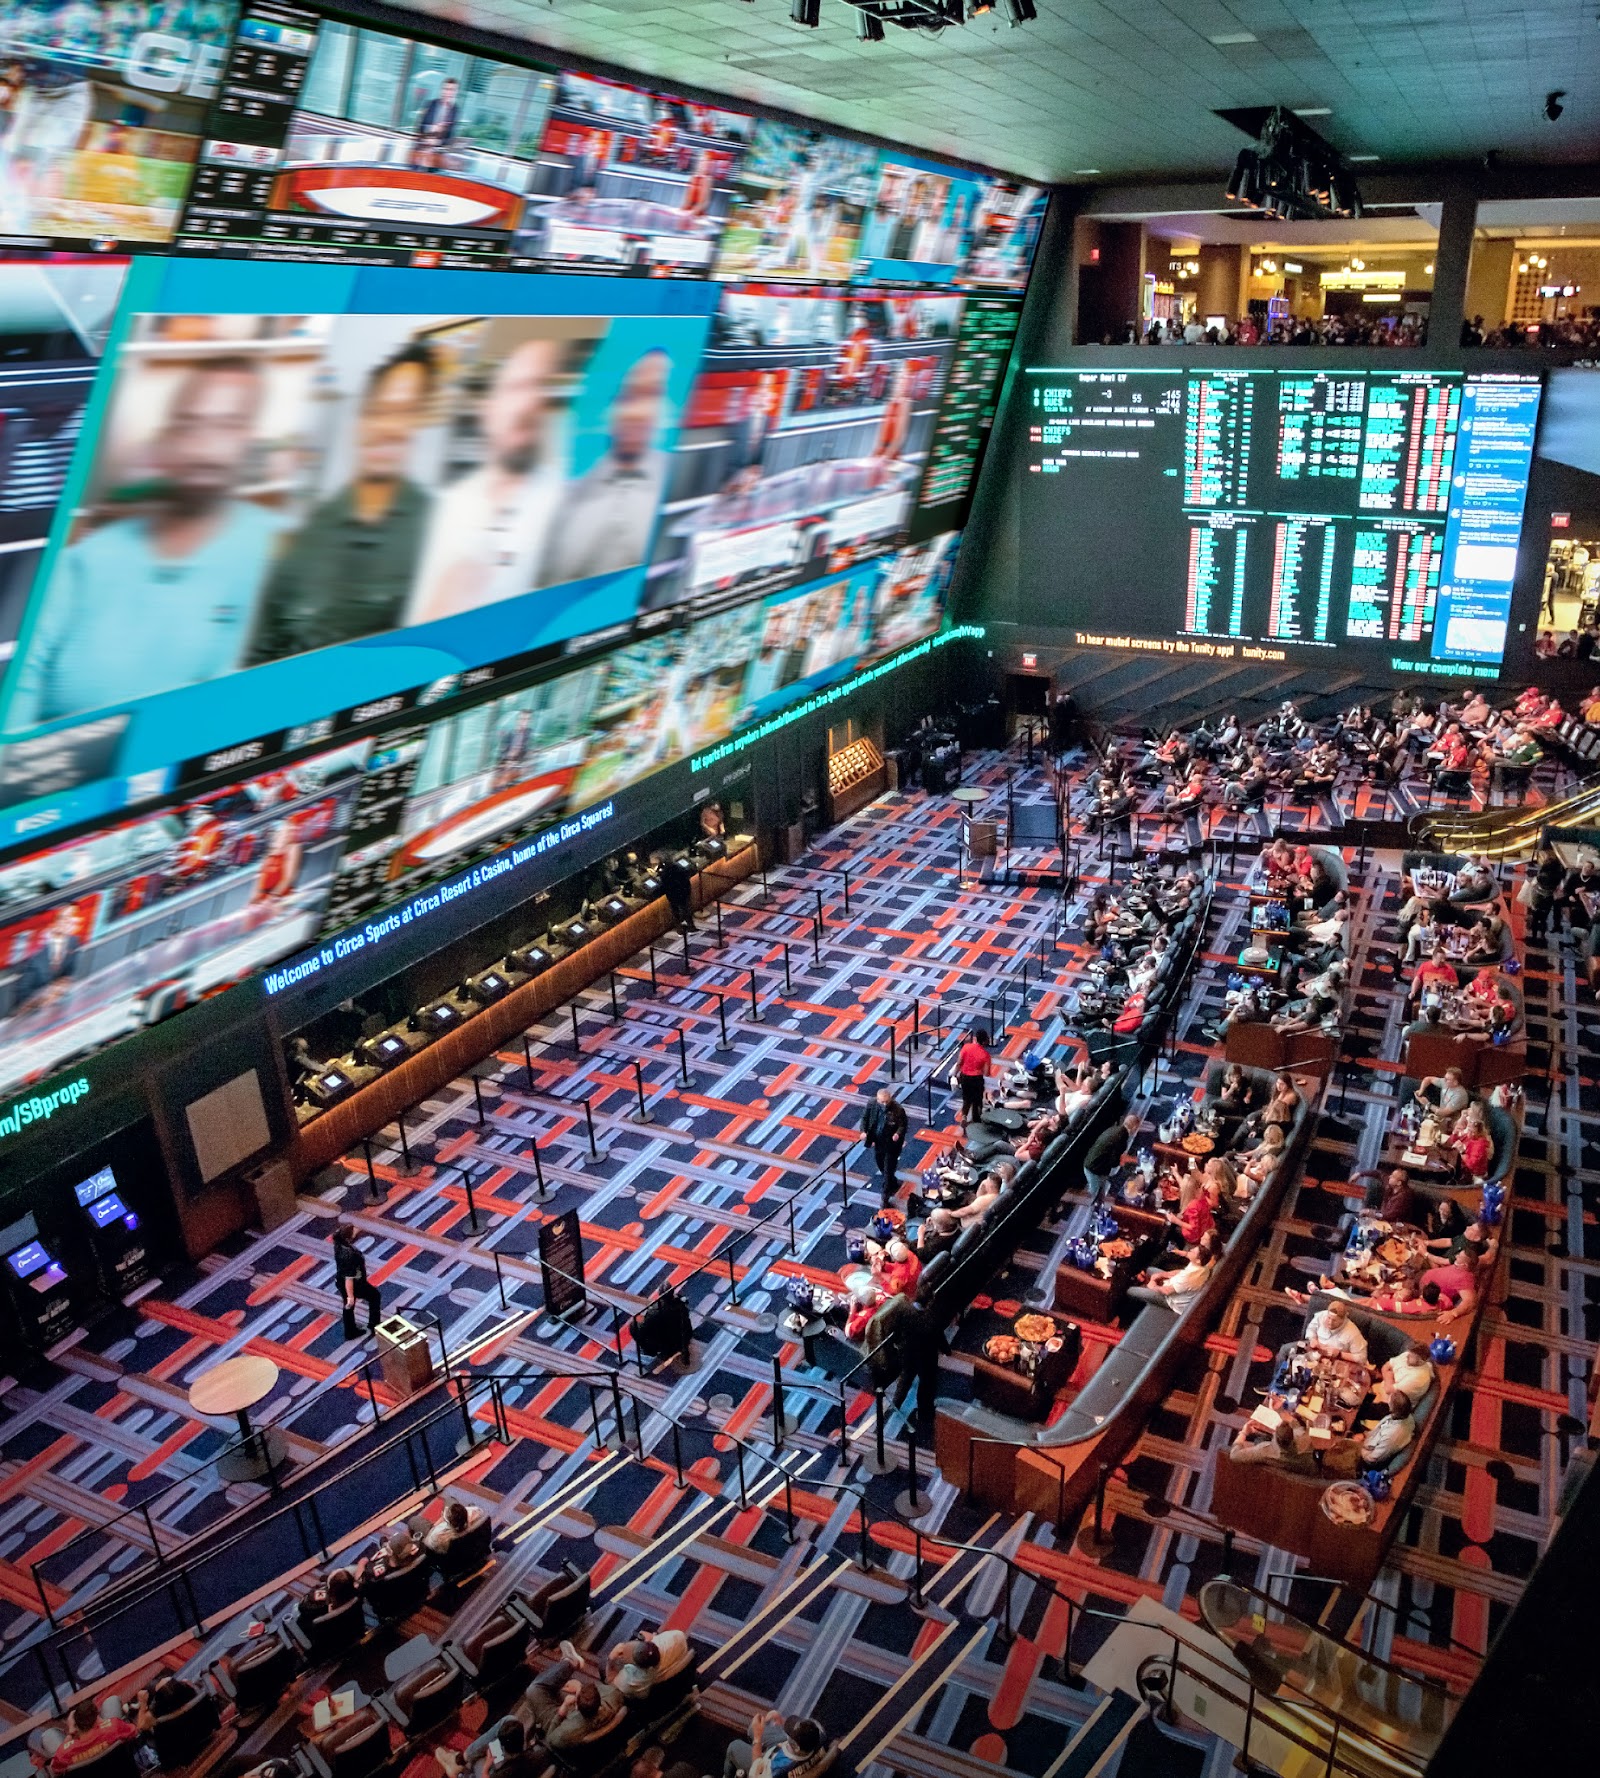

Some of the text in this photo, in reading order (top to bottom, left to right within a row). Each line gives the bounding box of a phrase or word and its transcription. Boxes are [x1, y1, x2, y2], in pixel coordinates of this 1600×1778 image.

[1078, 374, 1098, 383] Super
[1043, 389, 1072, 399] CHIEFS
[1101, 389, 1112, 399] -3
[1161, 390, 1182, 399] -165
[1131, 393, 1142, 404] 55
[1043, 398, 1064, 407] BUCS
[1160, 399, 1181, 409] +146
[1043, 426, 1071, 436] CHIEFS
[1042, 435, 1062, 444] BUCS
[1075, 633, 1086, 644] To
[1087, 633, 1104, 646] hear
[1105, 635, 1130, 648] muted
[1131, 639, 1161, 650] screens
[1162, 639, 1175, 653] try
[1176, 640, 1189, 652] the
[1190, 642, 1215, 656] Tunity
[1242, 646, 1285, 661] tunity.com
[1392, 658, 1500, 678] View our complete menu
[691, 756, 702, 773] Bet
[702, 749, 720, 768] sports
[264, 801, 614, 995] Welcome to Circa Sports at Circa Resort & Casino, home of the Circa Squares!
